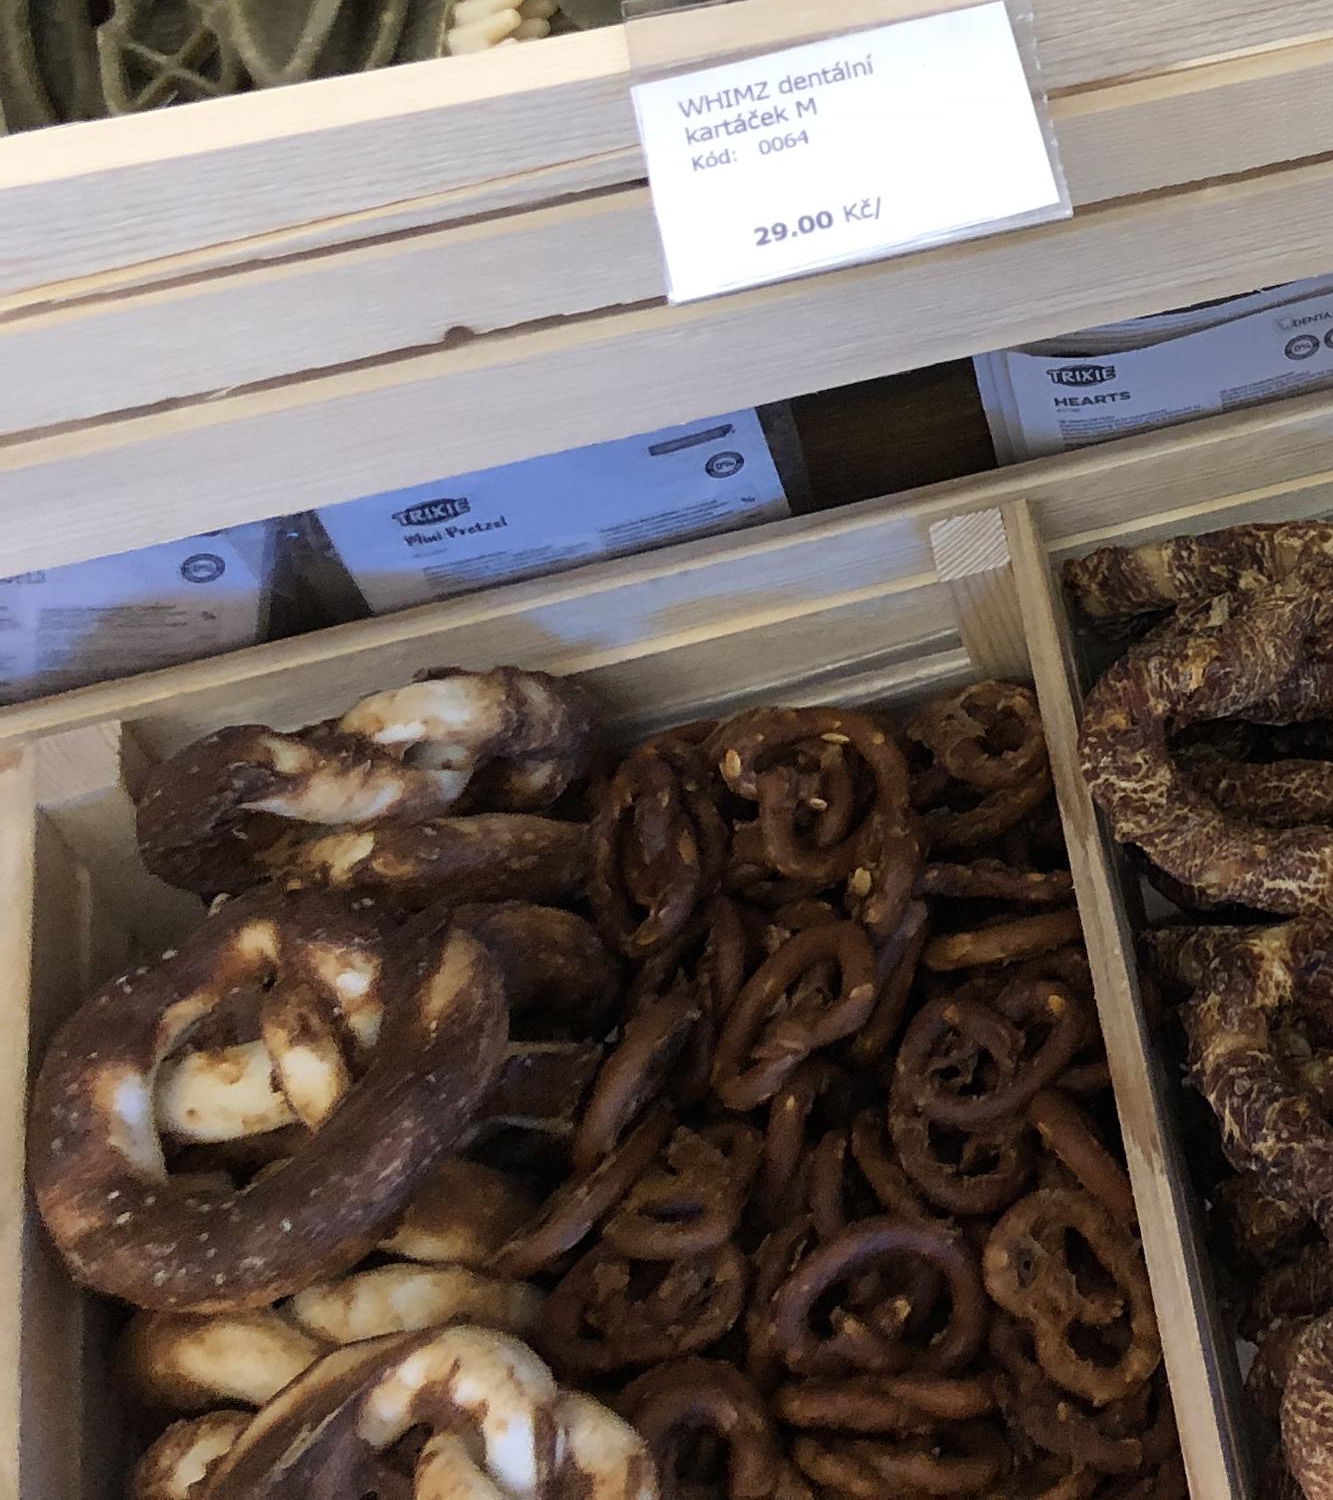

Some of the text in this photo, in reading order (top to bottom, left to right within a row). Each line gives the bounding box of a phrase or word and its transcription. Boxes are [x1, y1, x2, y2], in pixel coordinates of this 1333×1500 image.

[677, 52, 875, 119] WHIMZ dentální
[684, 96, 818, 146] kartáček M
[691, 129, 810, 173] Kód: 0064
[753, 210, 834, 247] 29.00
[1046, 363, 1117, 388] TRIXIE
[1053, 390, 1132, 408] HEARTS
[391, 496, 472, 527] TRIXIE
